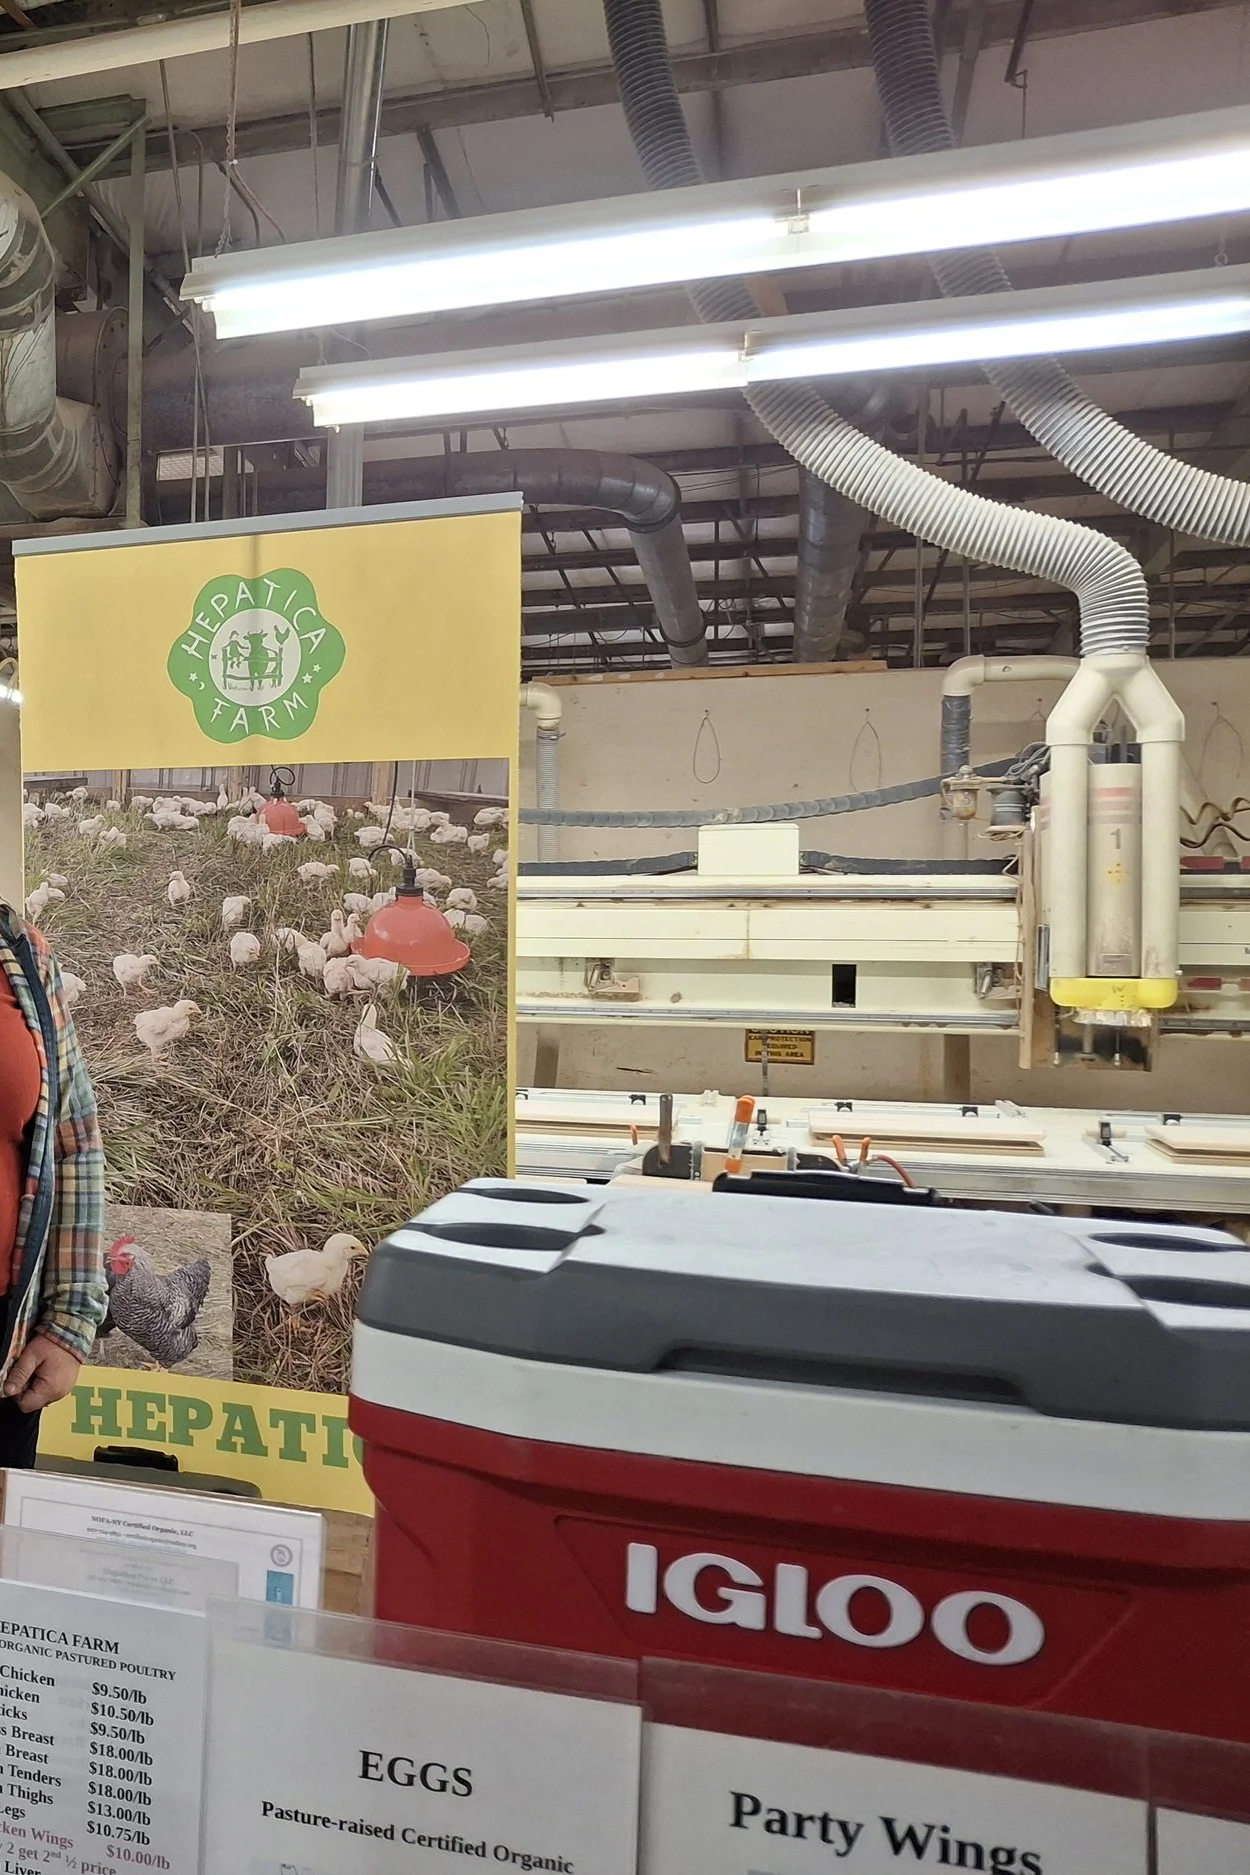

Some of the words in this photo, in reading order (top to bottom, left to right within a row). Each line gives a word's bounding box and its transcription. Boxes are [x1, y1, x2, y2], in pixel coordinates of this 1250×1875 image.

[181, 578, 327, 660] HEPATICA
[210, 691, 309, 734] FARM
[71, 1385, 363, 1469] HEPATI
[625, 1541, 1046, 1667] IGLOO
[72, 1633, 120, 1655] FARM
[0, 1665, 56, 1687] Chicken
[91, 1682, 148, 1704] $9.50/lb
[55, 1650, 117, 1671] PASTURED
[119, 1662, 177, 1681] POULTRY
[89, 1722, 146, 1745] $9.50/lb
[90, 1702, 155, 1726] $10.50/lb
[5, 1744, 50, 1765] Breast
[88, 1761, 153, 1786] $18.00/lb
[11, 1726, 55, 1747] Breast
[89, 1742, 154, 1766] $18.00/lb
[7, 1764, 62, 1787] Tenders
[87, 1781, 152, 1806] $18.00/lb
[357, 1749, 474, 1798] EGGS
[6, 1783, 54, 1805] Thighs
[87, 1801, 152, 1826] $13.00/lb
[30, 1827, 75, 1849] Wings
[106, 1844, 171, 1871] $10.00/lb
[86, 1820, 151, 1846] $10.75/lb
[261, 1800, 395, 1841] Pasture-raised
[401, 1827, 487, 1859] Certified
[493, 1844, 575, 1875] Organic
[728, 1790, 865, 1857] Party
[878, 1815, 1043, 1875] Wings
[6, 1841, 15, 1855] 2
[18, 1846, 39, 1861] get
[80, 1860, 117, 1875] price
